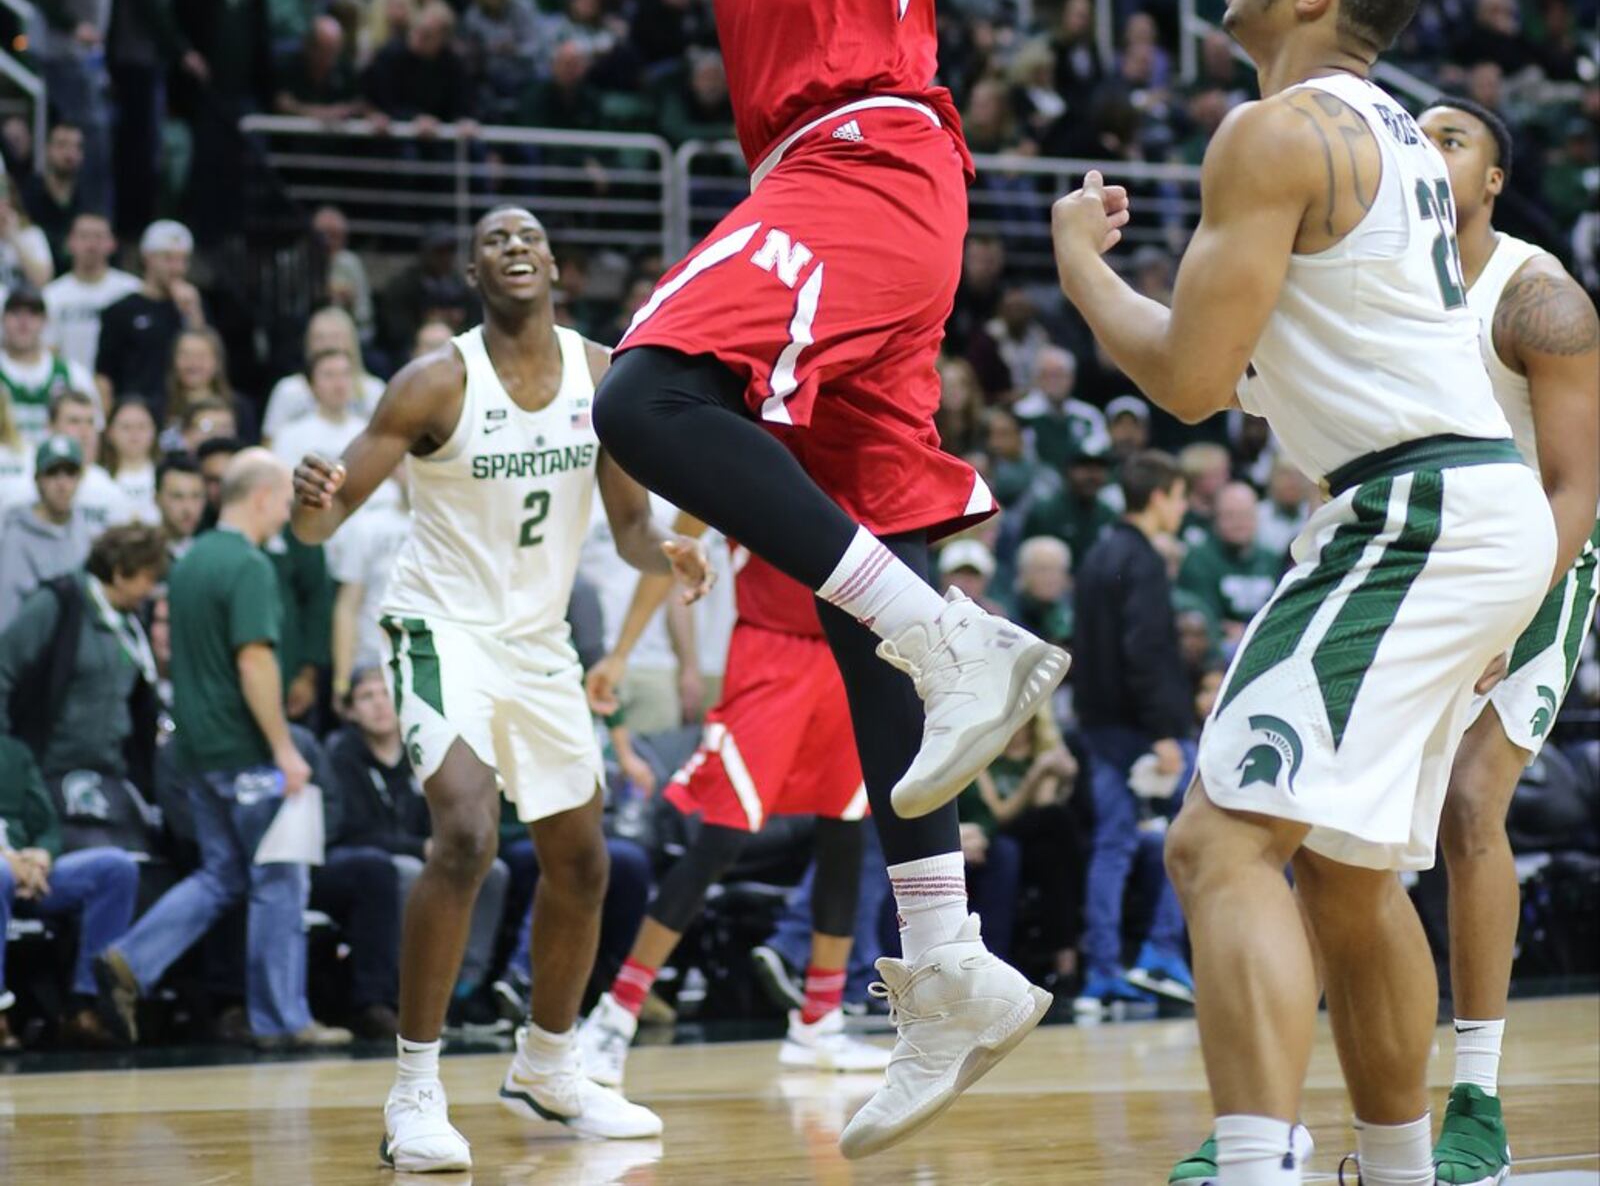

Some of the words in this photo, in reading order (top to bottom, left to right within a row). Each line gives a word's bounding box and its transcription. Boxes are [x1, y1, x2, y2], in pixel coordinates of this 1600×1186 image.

[750, 227, 814, 289] N
[472, 444, 594, 480] SPARTANS
[519, 488, 552, 548] 2
